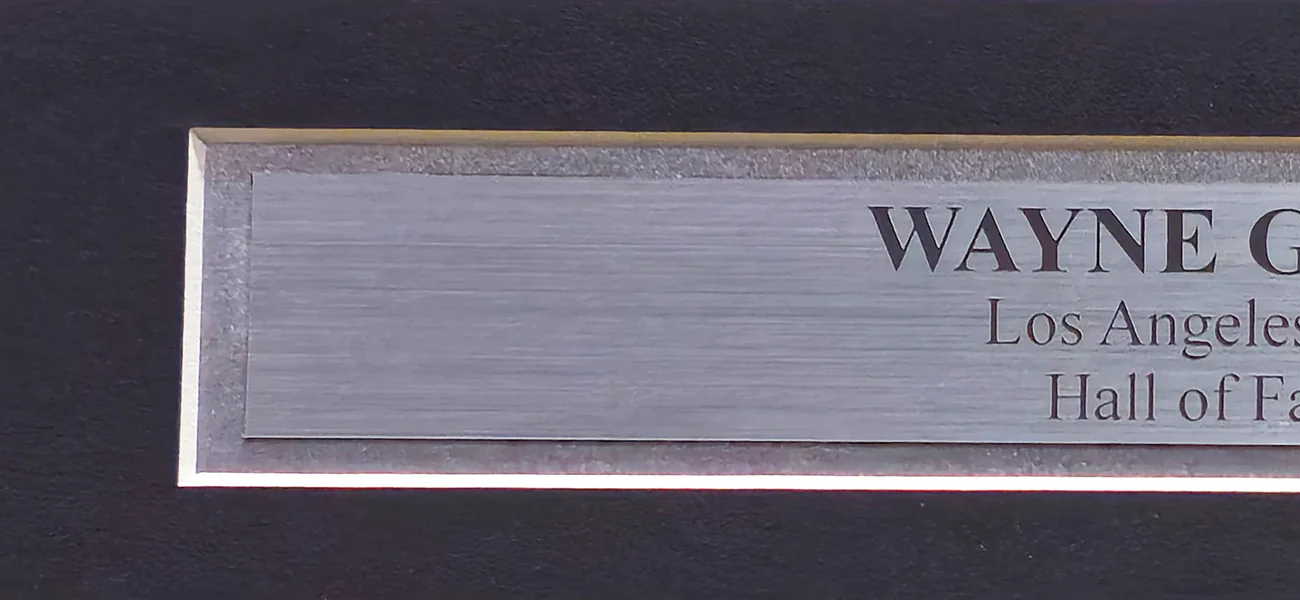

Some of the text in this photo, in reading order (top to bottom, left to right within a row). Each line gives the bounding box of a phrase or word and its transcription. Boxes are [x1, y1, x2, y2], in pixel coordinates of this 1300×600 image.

[868, 205, 1217, 274] WAYNE
[986, 297, 1083, 346] Los
[1047, 372, 1155, 421] Hall
[1178, 372, 1241, 421] of
